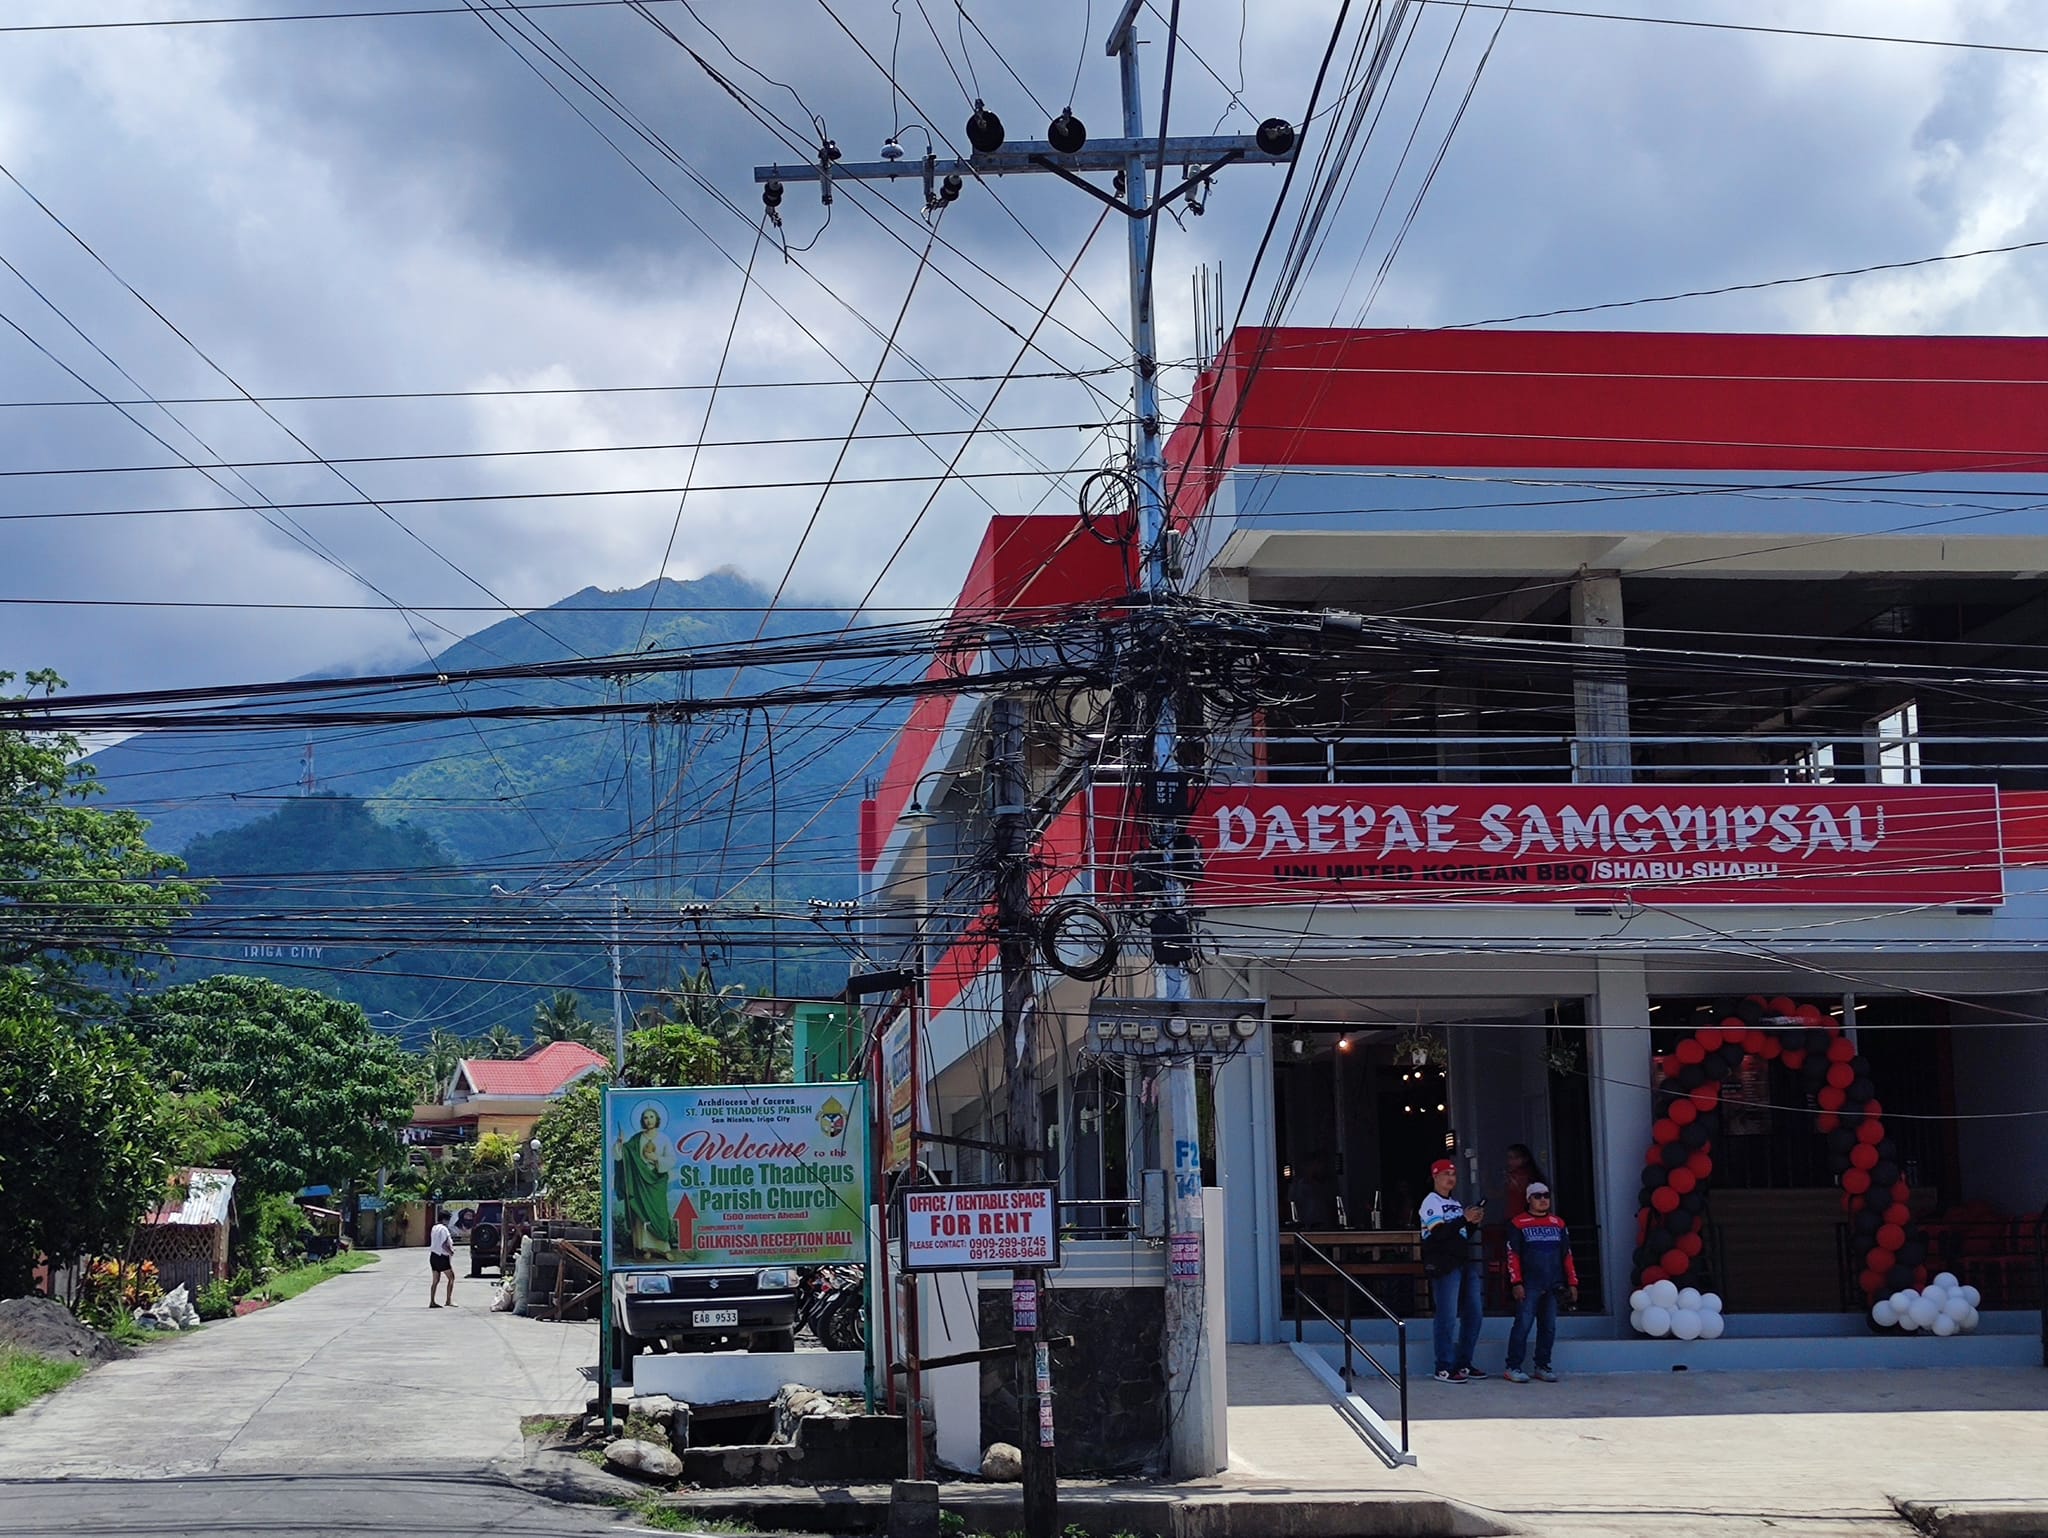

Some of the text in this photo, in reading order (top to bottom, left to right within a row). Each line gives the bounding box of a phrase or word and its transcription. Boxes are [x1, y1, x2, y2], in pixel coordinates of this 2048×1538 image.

[1213, 804, 1880, 860] DAEPAE SAMGYUPSAL
[1273, 865, 1412, 882] UNLIMITED
[1414, 865, 1527, 882] KOREAN
[244, 945, 322, 959] IRIGA CITY
[697, 1097, 795, 1106] Archdiocese of Caceres
[686, 1105, 812, 1116] ST. JUDE THADDEUS PARISH
[777, 1115, 790, 1123] City
[677, 1130, 847, 1161] Welcome to the
[680, 1162, 854, 1187] St. Jude Thaddeus
[700, 1187, 836, 1210] Parish Church
[910, 1192, 1046, 1212] OFFICE / RENTABLE SPACE
[931, 1212, 1032, 1236] FOR RENT
[698, 1231, 852, 1248] GILKRISSA RECEPTION HALL
[909, 1236, 1046, 1249] PLEASE CONTACT: 0909-299-8745
[970, 1247, 1046, 1260] 0912-968-9646
[695, 1312, 736, 1323] EAB 9533
